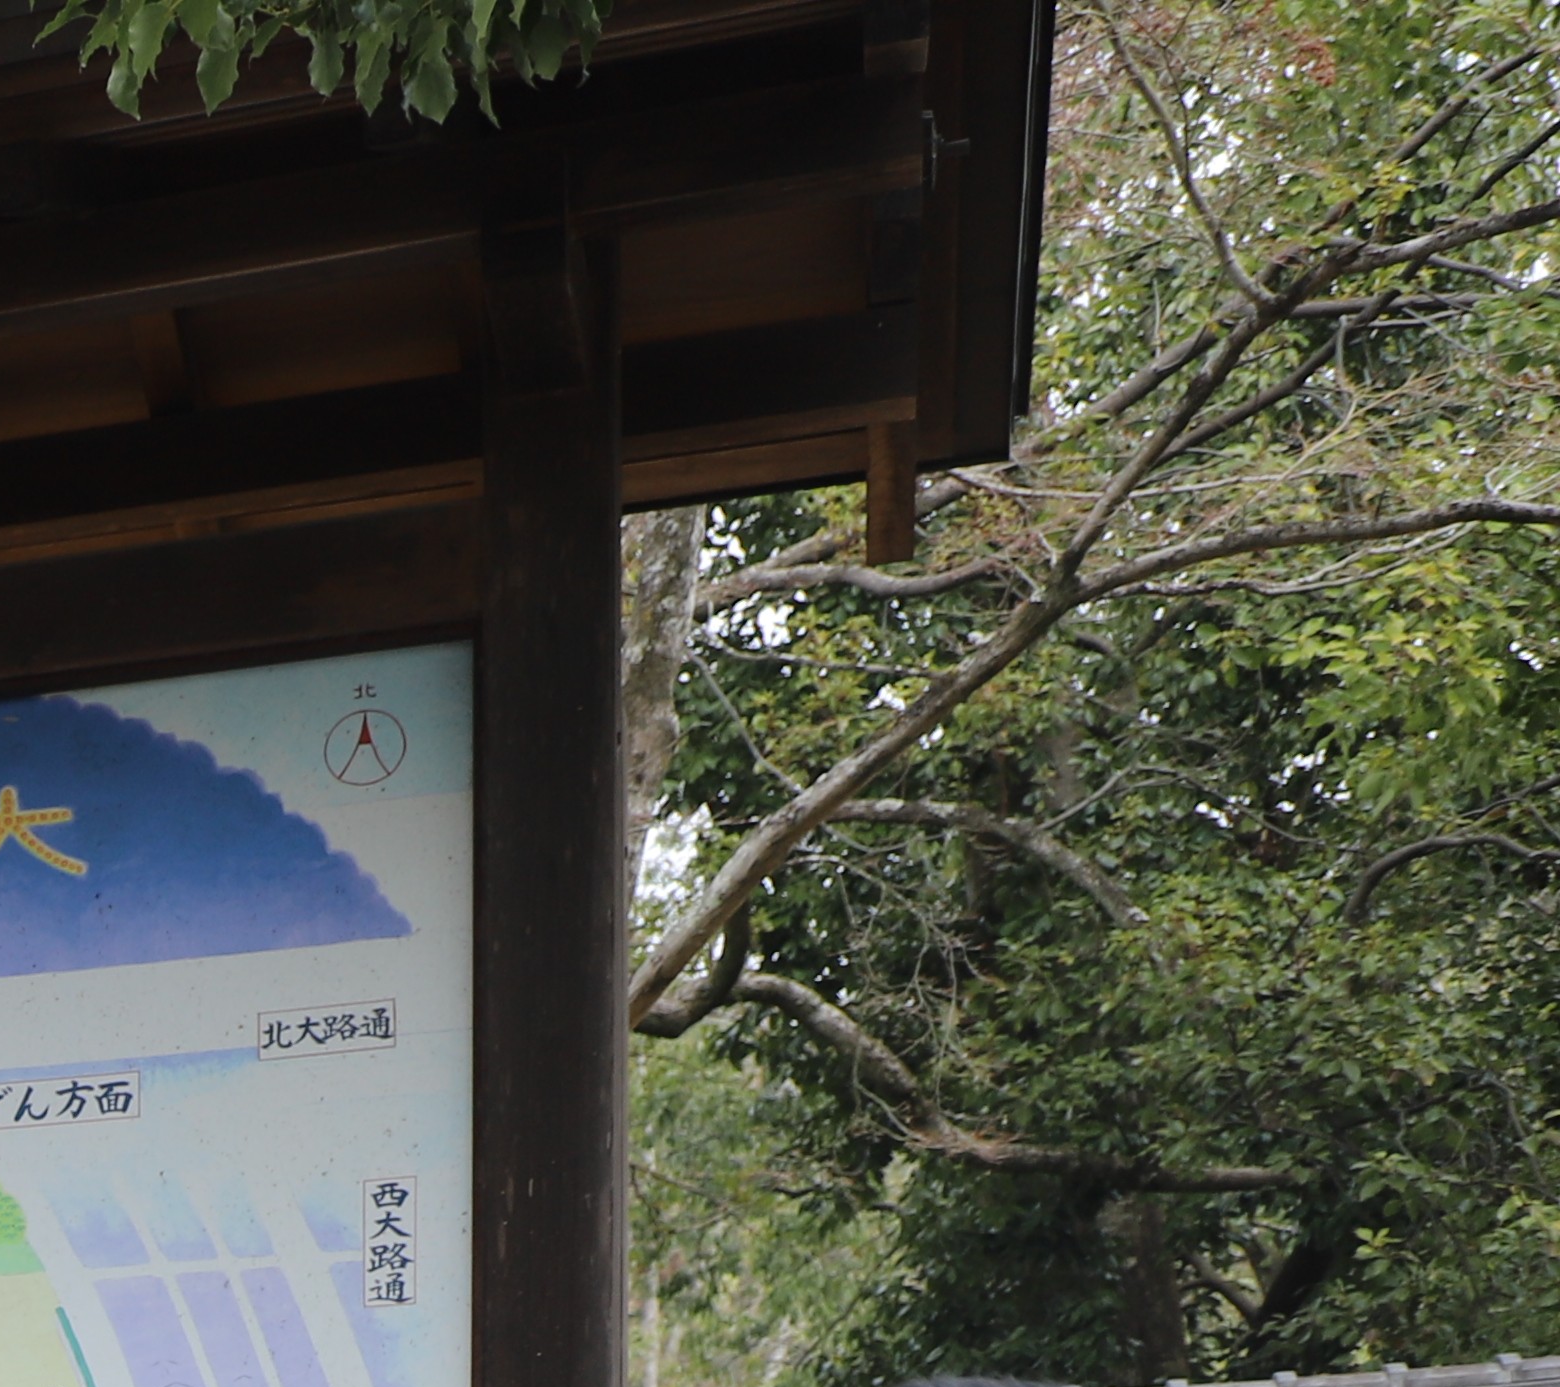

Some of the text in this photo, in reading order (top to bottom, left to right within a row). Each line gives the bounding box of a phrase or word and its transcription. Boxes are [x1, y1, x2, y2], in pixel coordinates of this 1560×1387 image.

[261, 1007, 395, 1050] 北大路通
[368, 1182, 413, 1304] 西大路通
